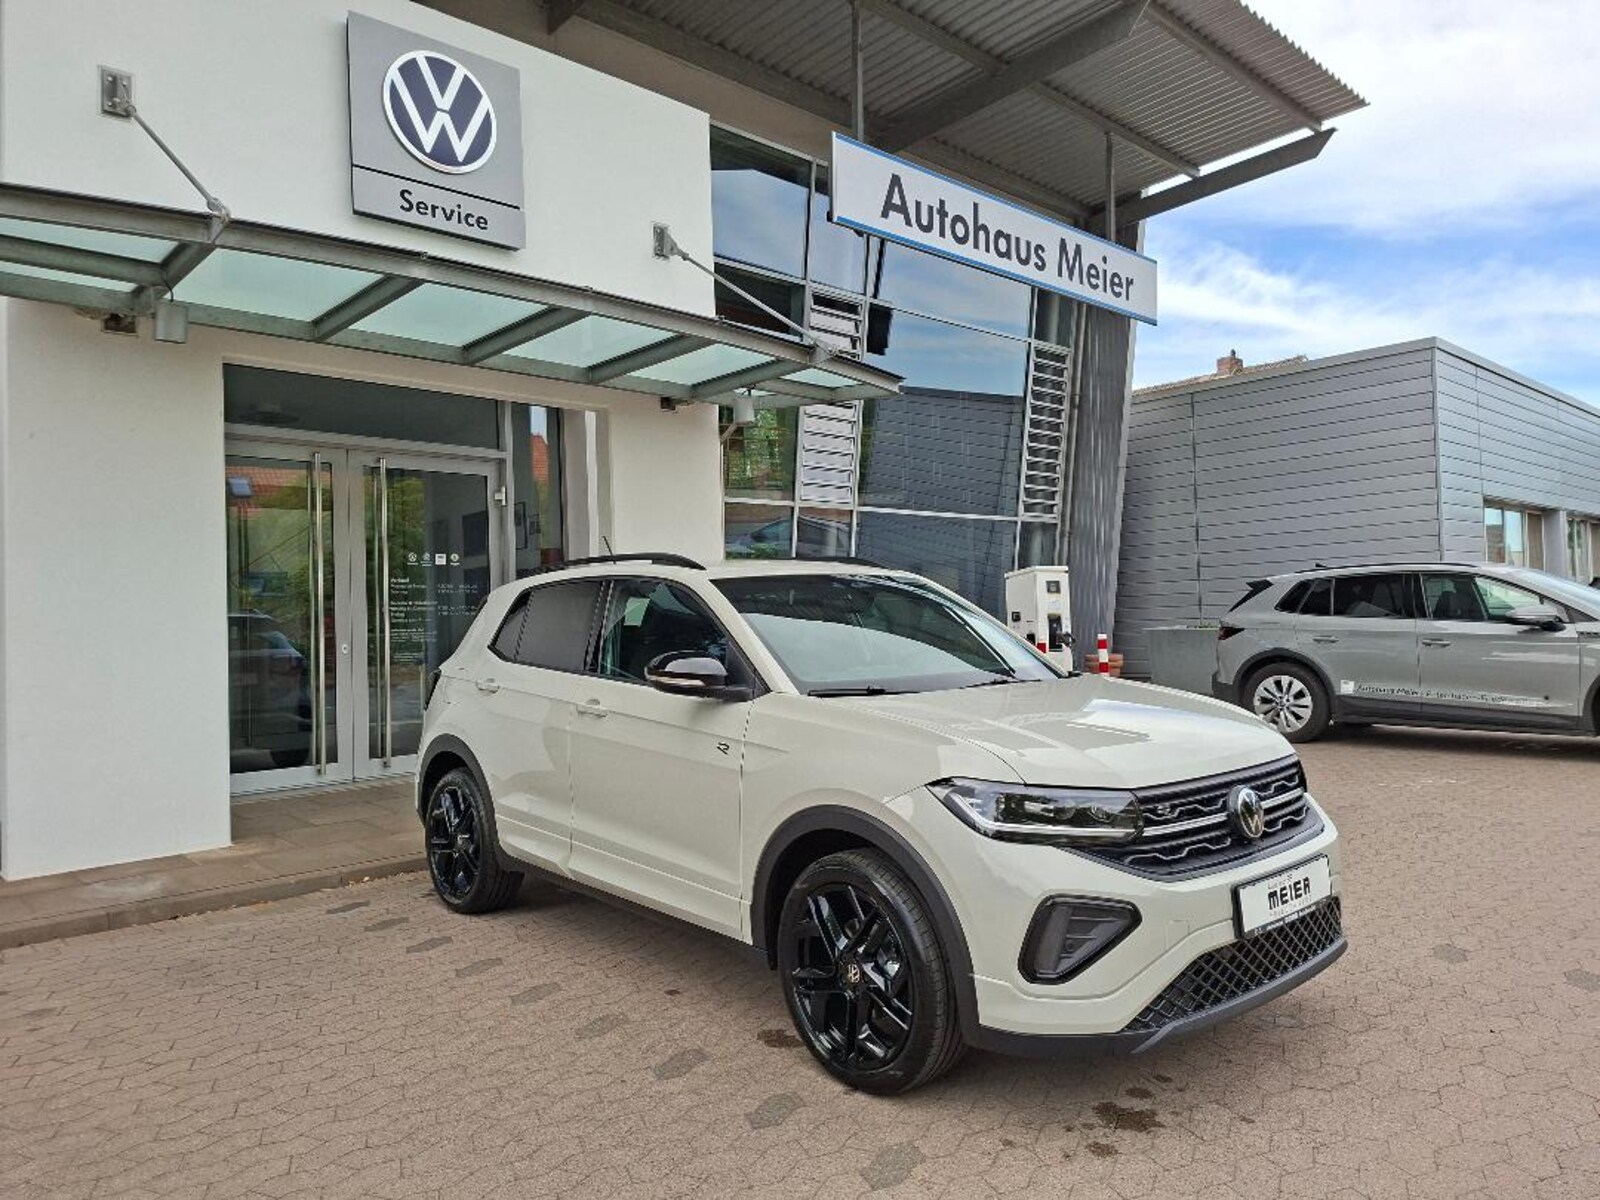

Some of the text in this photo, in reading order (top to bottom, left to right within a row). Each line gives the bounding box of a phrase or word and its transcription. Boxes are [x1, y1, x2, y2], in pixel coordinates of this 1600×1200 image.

[399, 189, 488, 230] Service
[881, 173, 1134, 301] Autohaus Meier
[1267, 876, 1311, 910] MEIER
